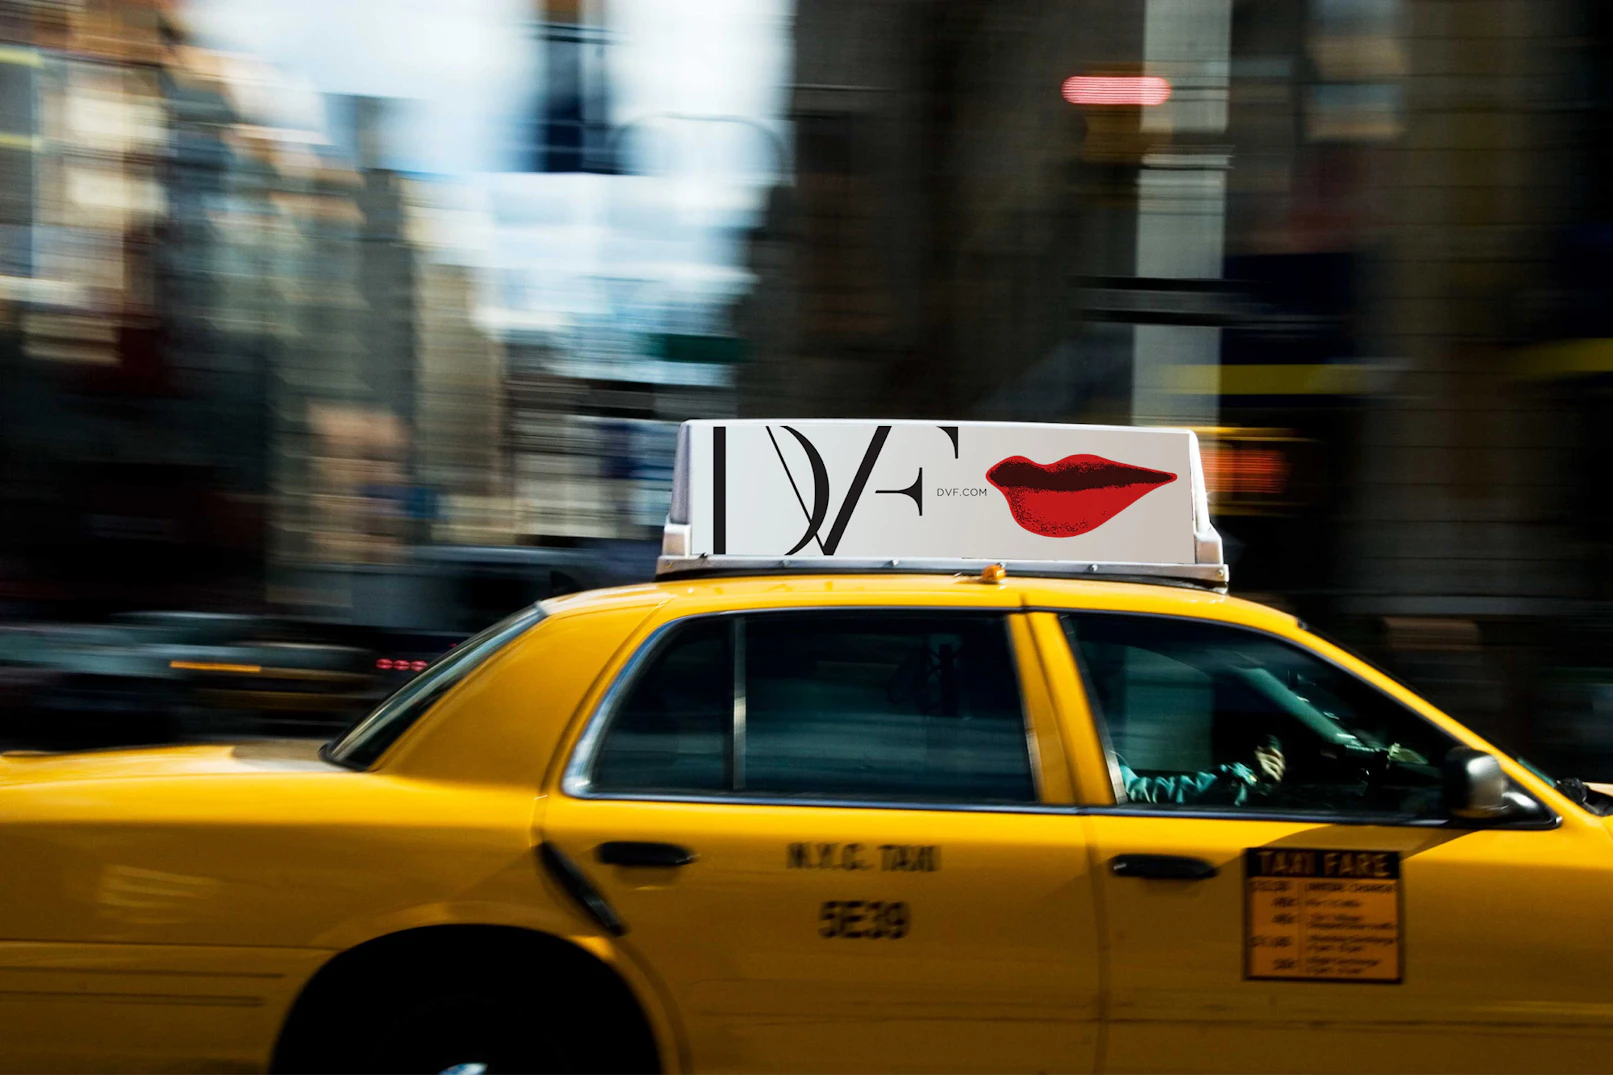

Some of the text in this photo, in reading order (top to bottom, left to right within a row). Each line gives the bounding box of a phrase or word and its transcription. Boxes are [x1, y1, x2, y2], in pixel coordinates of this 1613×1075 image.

[713, 426, 958, 555] DVF
[936, 488, 987, 497] DVF.COM
[878, 845, 942, 872] TAXI
[1257, 851, 1391, 877] TAXI FARE
[818, 901, 911, 940] 5E39
